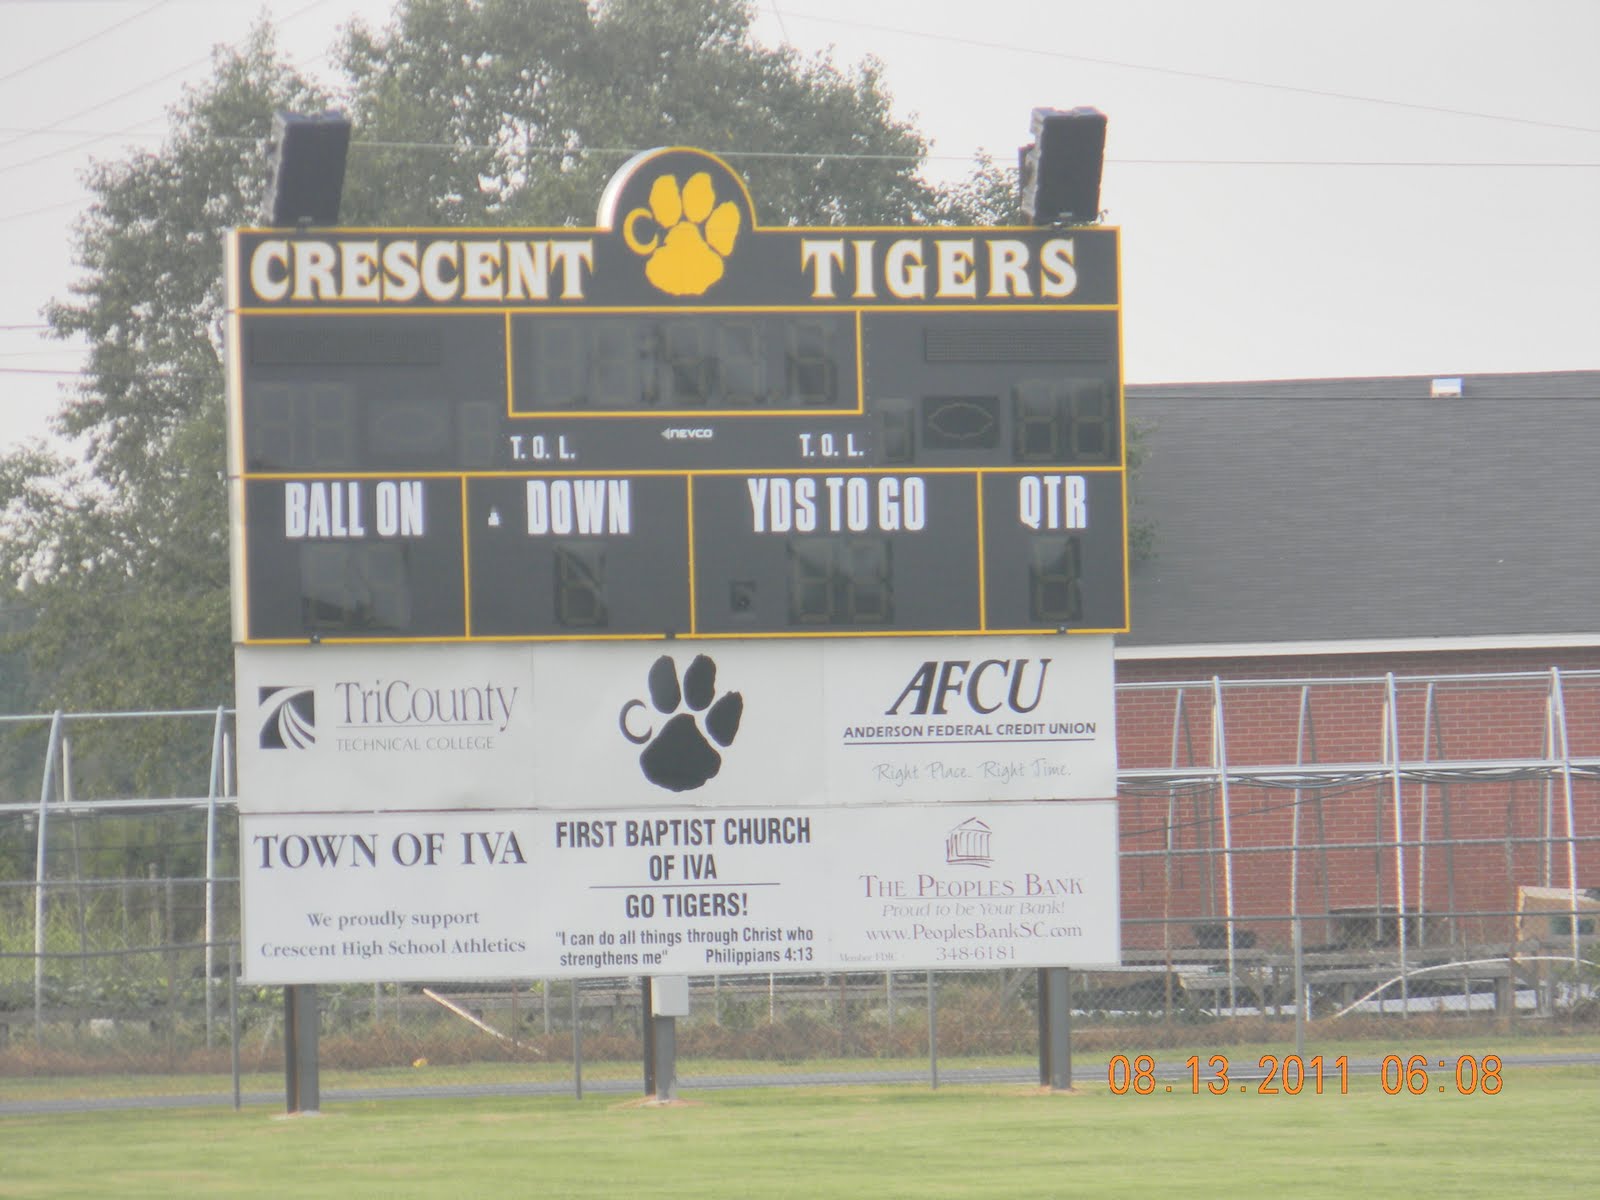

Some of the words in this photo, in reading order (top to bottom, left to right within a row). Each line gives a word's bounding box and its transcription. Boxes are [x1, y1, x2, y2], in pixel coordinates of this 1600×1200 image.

[249, 239, 595, 302] CRESCENT
[800, 237, 1078, 299] TIGERS
[285, 482, 365, 538] BALL
[375, 481, 425, 537] ON
[526, 479, 631, 535] DOWN
[747, 478, 816, 532] YDS
[826, 478, 869, 531] TO
[878, 476, 926, 531] GO
[1019, 475, 1087, 530] QTR
[885, 658, 1052, 715] AFCU
[335, 679, 519, 732] TriCounty
[843, 726, 924, 739] ANDERSON
[927, 724, 993, 737] FEDERAL
[996, 723, 1045, 735] CREDIT
[1048, 722, 1096, 734] UNION
[336, 738, 421, 752] TECHNICAL
[426, 736, 496, 751] COLLEGE
[872, 761, 919, 787] Right
[977, 759, 1026, 784] Right
[1032, 757, 1072, 777] Time.
[555, 820, 618, 848] FIRST
[625, 819, 716, 847] BAPTIST
[724, 817, 811, 845] CHURCH
[253, 833, 379, 869] TOWN
[391, 832, 445, 867] OF
[460, 831, 528, 866] IVA
[649, 854, 675, 881] OF
[683, 854, 717, 880] IVA
[859, 874, 907, 897] THE
[918, 874, 1015, 896] PEOPLES
[1025, 873, 1084, 896] BANK
[625, 894, 655, 918] GO
[662, 892, 748, 918] TIGERS!
[882, 903, 930, 917] Proud
[935, 903, 951, 916] to
[955, 902, 975, 915] be
[979, 902, 1015, 915] Your
[307, 912, 333, 927] We
[338, 910, 407, 930] proudly
[411, 911, 480, 930] support
[261, 942, 336, 957] Crescent
[342, 939, 383, 959] High
[388, 939, 446, 955] School
[451, 938, 527, 953] Athletics
[570, 933, 594, 945] can
[599, 931, 615, 945] do
[619, 930, 636, 944] all
[640, 929, 682, 949] things
[687, 928, 738, 946] through
[743, 927, 782, 941] Christ
[786, 927, 814, 941] who
[560, 951, 639, 968] strengthens
[706, 948, 780, 965] Philippians
[784, 947, 813, 961] 4:13
[936, 947, 1015, 961] 348-6181
